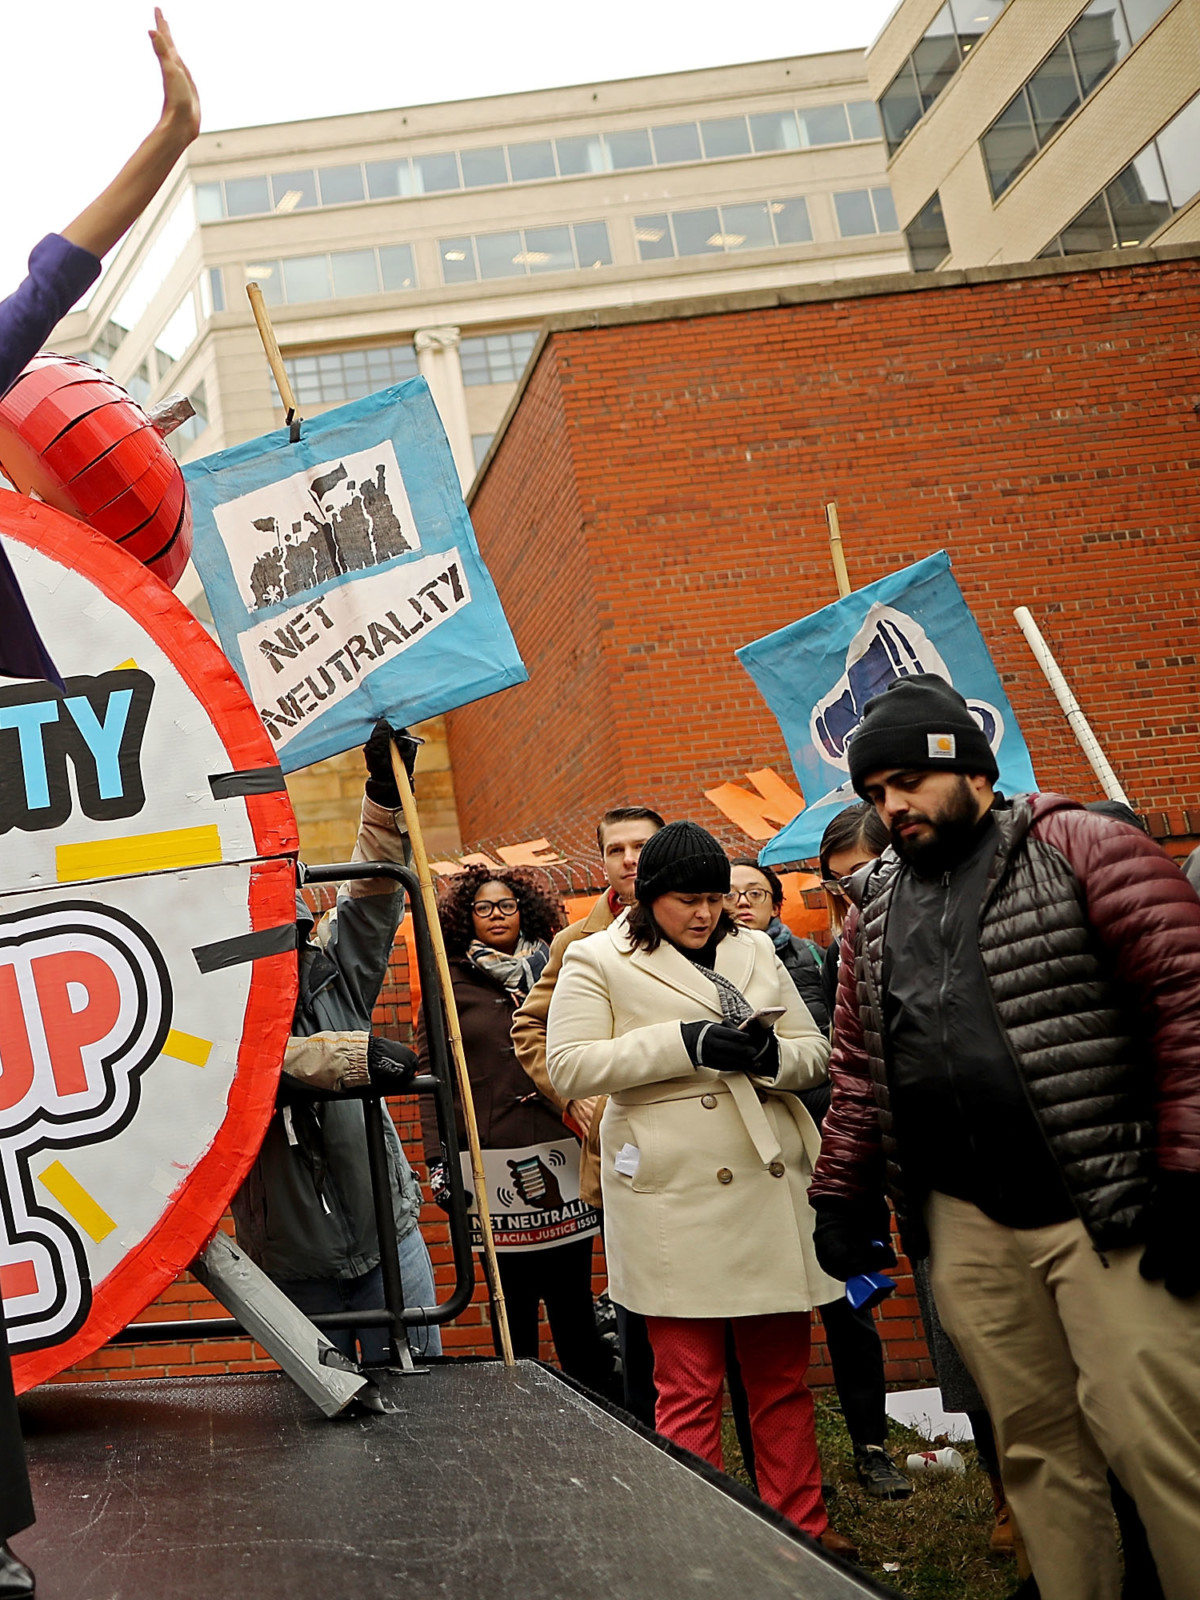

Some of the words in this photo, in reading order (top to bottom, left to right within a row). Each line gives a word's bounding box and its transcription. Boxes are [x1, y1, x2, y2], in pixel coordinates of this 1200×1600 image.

[258, 594, 334, 674] NET
[260, 562, 465, 741] NEUTRALITY
[494, 1232, 534, 1243] RACIAL
[535, 1221, 577, 1240] JUSTICE
[577, 1214, 598, 1230] ISSU
[507, 1200, 589, 1230] NEUTRALIT
